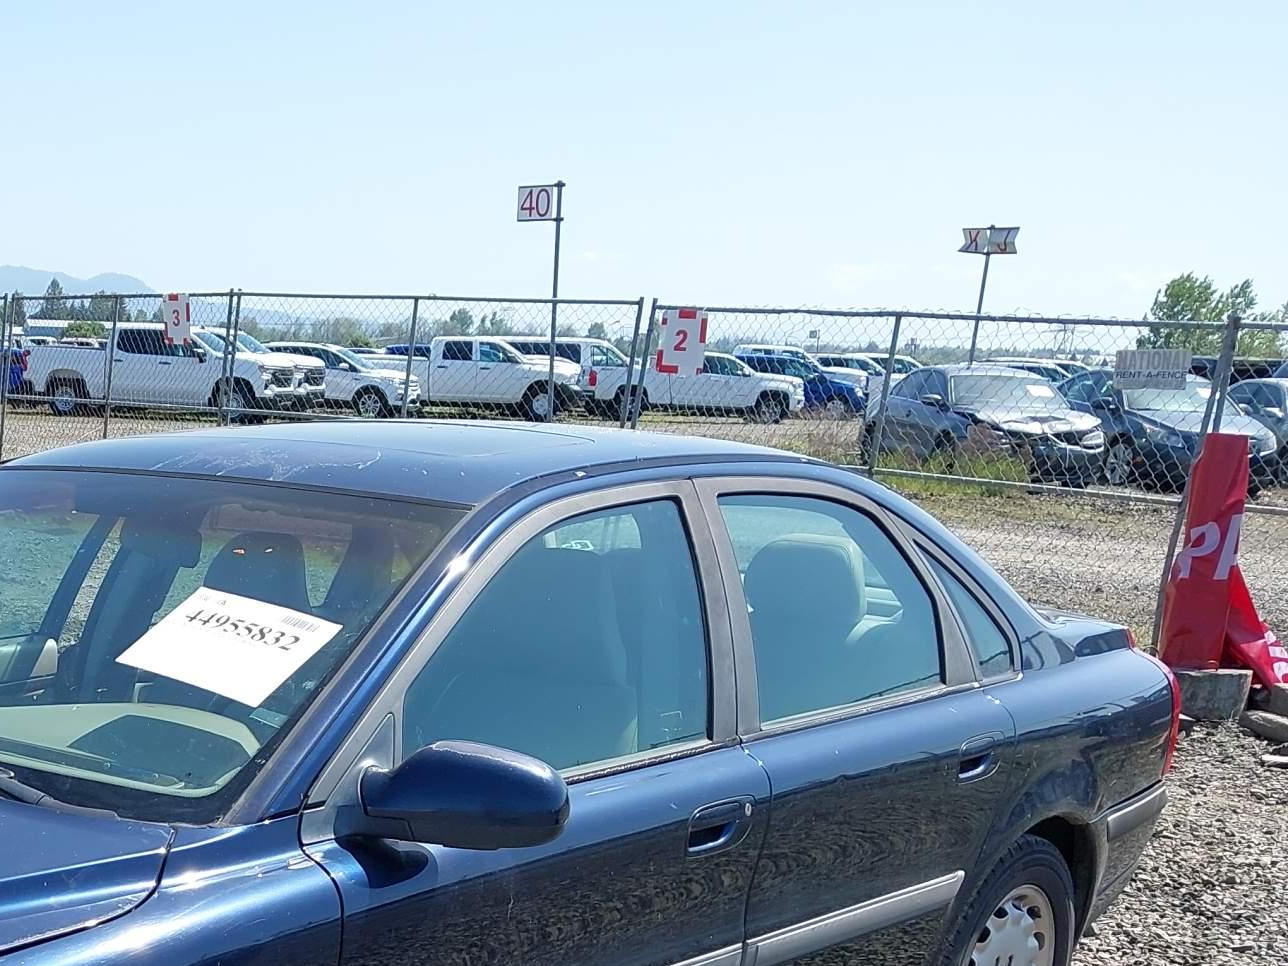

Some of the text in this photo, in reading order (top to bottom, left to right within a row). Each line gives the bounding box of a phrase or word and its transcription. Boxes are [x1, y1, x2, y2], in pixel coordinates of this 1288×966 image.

[520, 188, 550, 217] 40
[996, 230, 1011, 251] J
[172, 309, 181, 327] 3
[673, 329, 688, 352] 2
[1115, 350, 1189, 369] NATIONAL
[1114, 369, 1188, 379] RENT-A-FENCE
[185, 609, 301, 651] 44955832
